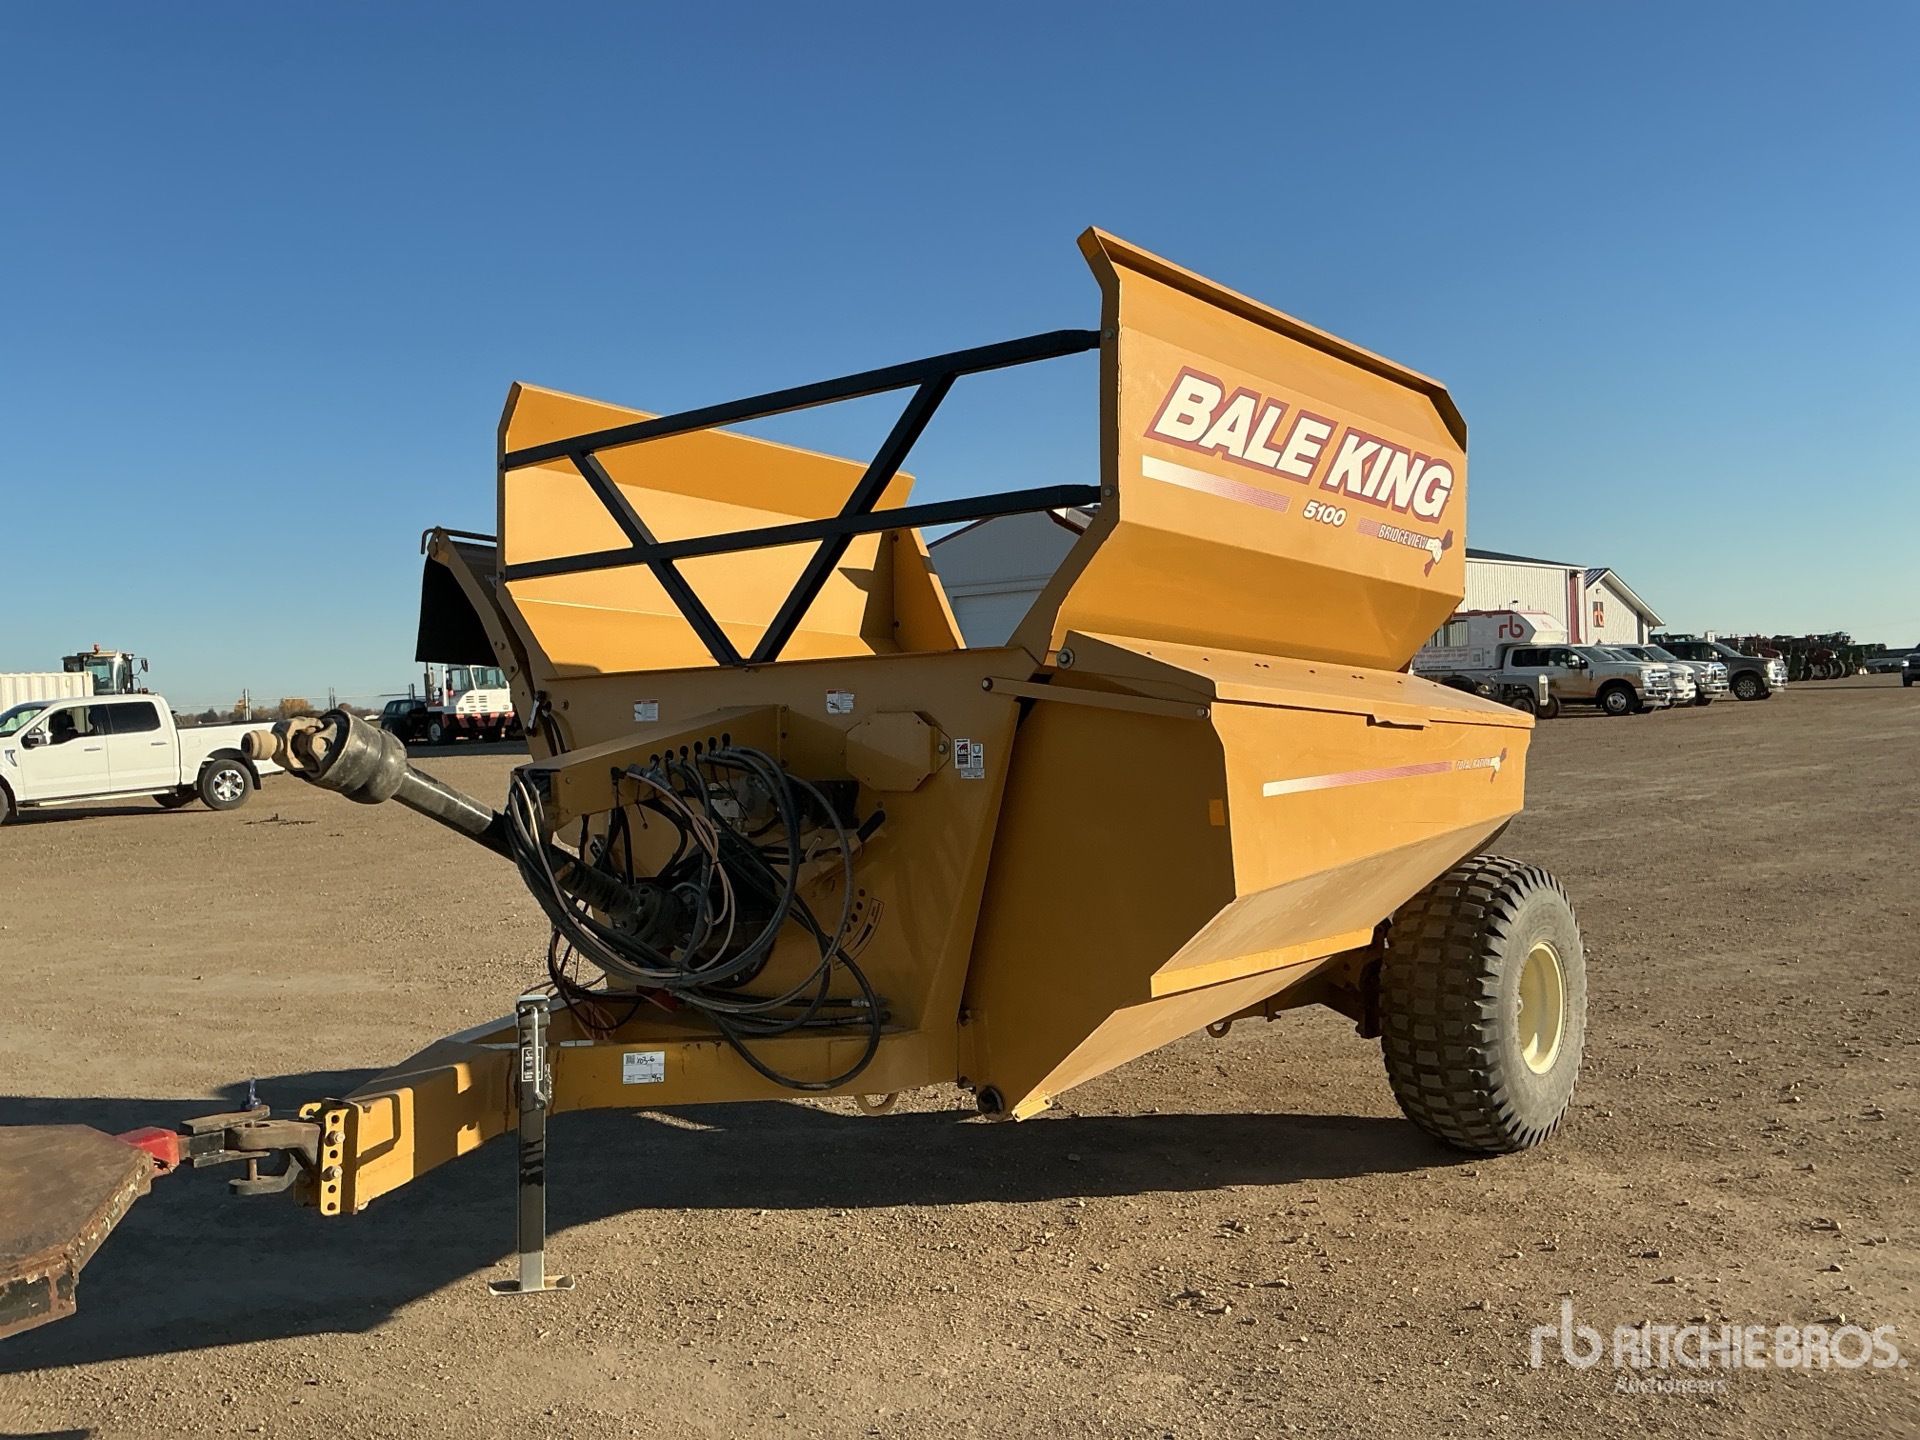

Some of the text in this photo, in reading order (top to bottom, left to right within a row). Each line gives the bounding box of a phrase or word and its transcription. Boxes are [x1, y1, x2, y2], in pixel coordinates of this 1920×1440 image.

[1152, 372, 1453, 520] BALE KING
[1303, 499, 1347, 527] 5100
[1378, 524, 1429, 550] BRIDGEVIEW
[1499, 615, 1524, 638] rb
